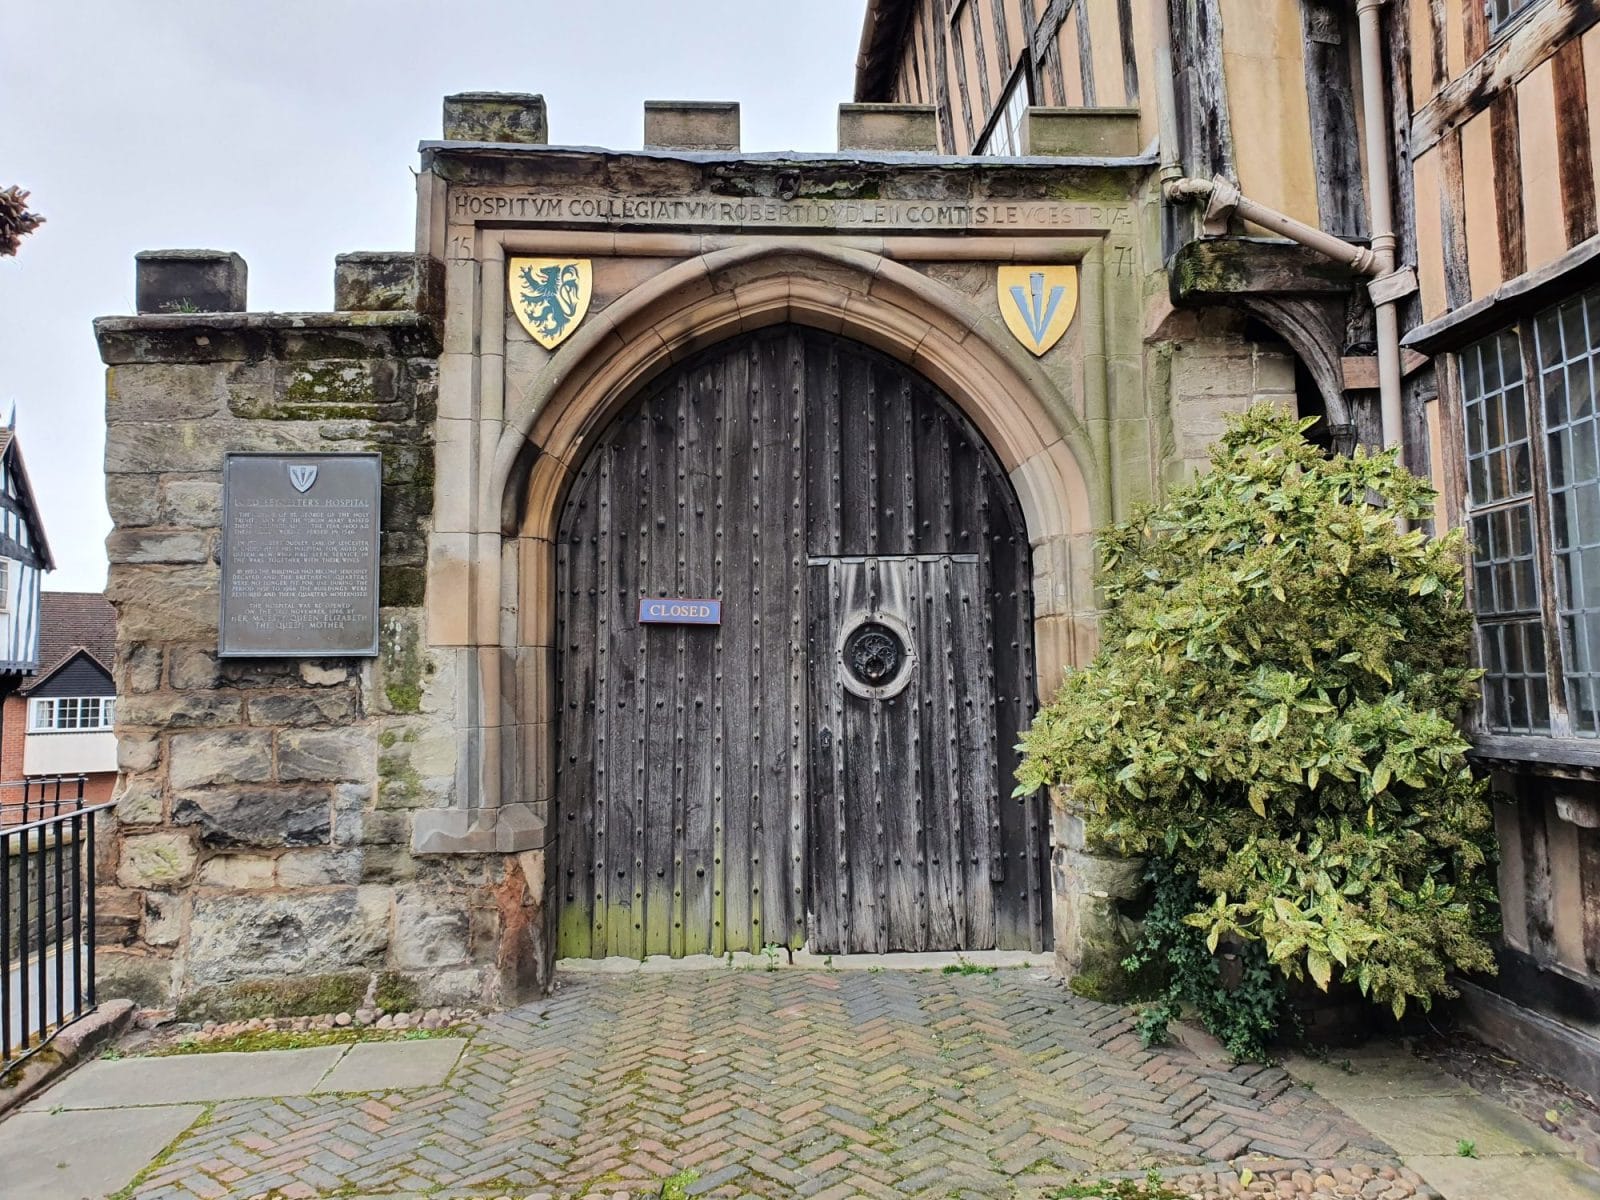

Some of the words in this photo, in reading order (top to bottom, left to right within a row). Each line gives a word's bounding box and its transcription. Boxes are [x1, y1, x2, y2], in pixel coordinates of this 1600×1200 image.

[568, 198, 717, 221] COLLEGIATVM
[234, 498, 260, 508] LD
[649, 604, 711, 617] CLOSED
